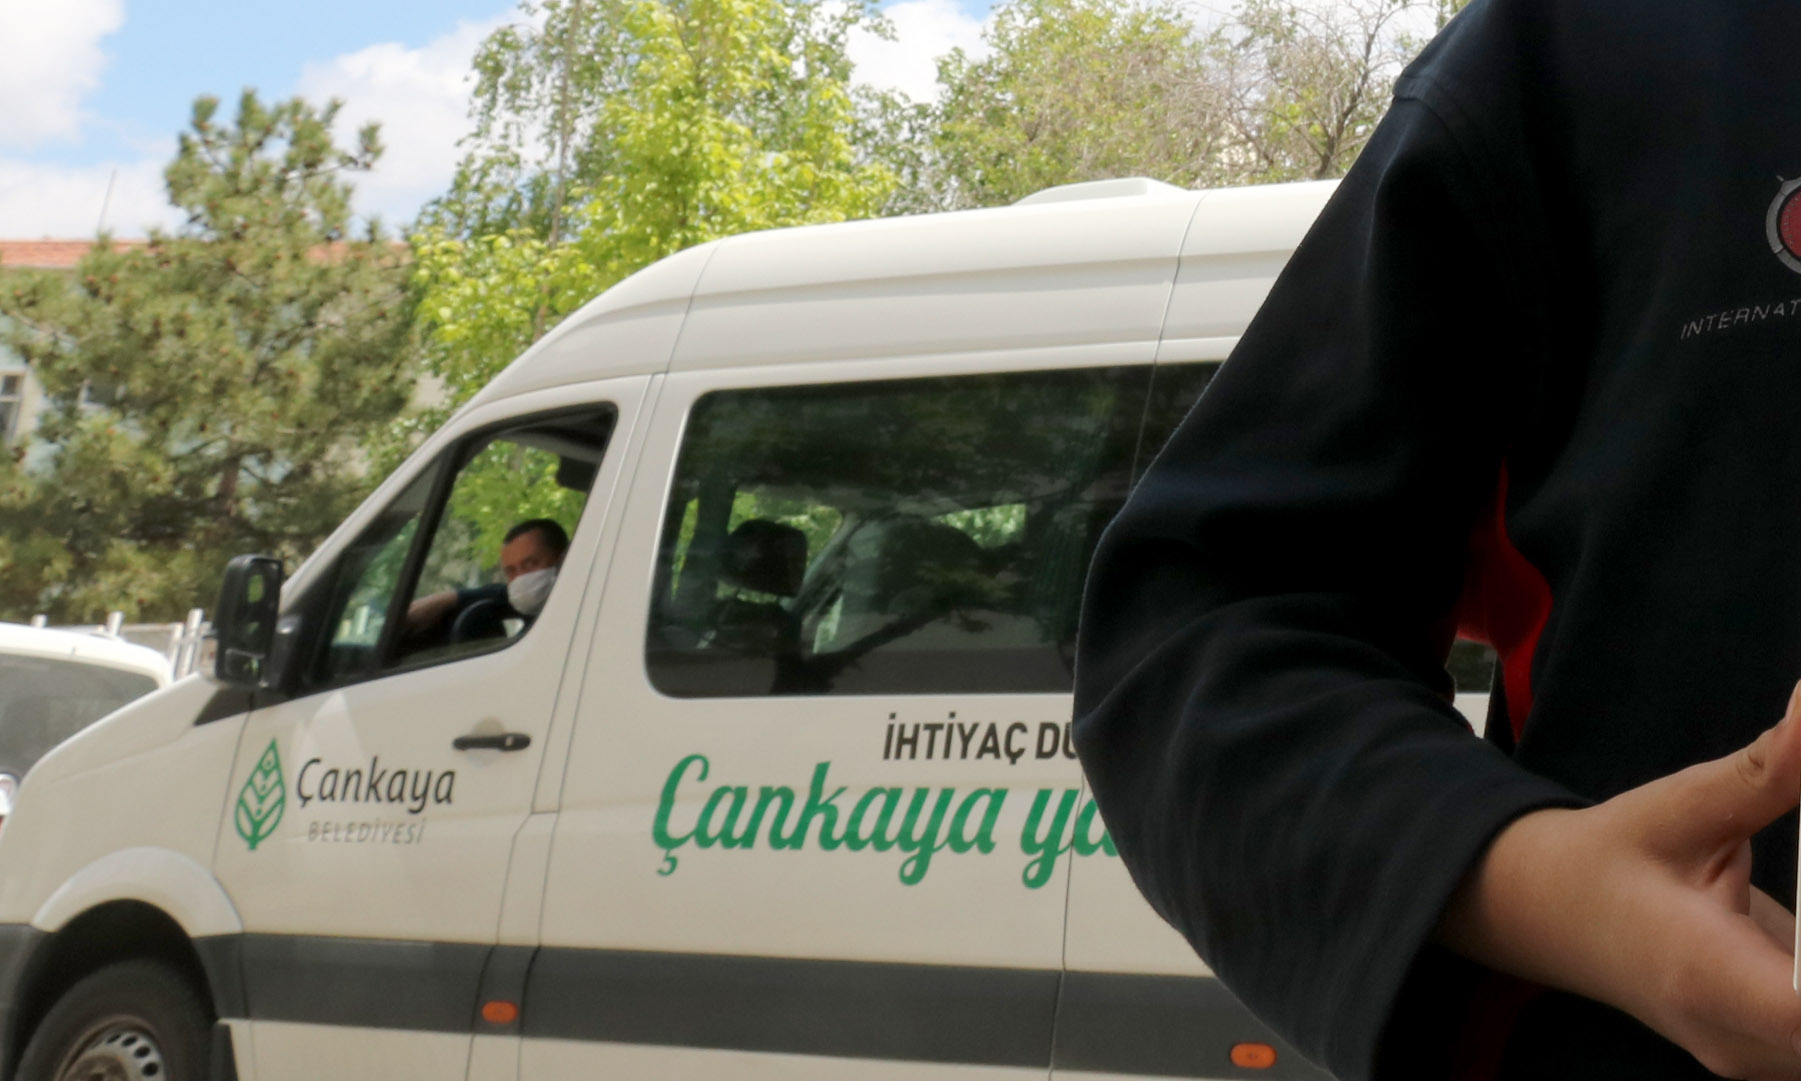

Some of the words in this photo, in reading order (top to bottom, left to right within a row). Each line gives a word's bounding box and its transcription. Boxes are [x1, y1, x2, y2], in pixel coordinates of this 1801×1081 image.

[882, 712, 1028, 765] İHTİYAÇ
[296, 755, 456, 814] Çankaya
[307, 817, 428, 845] BELEDİYESİ
[650, 753, 1010, 887] Çankaya
